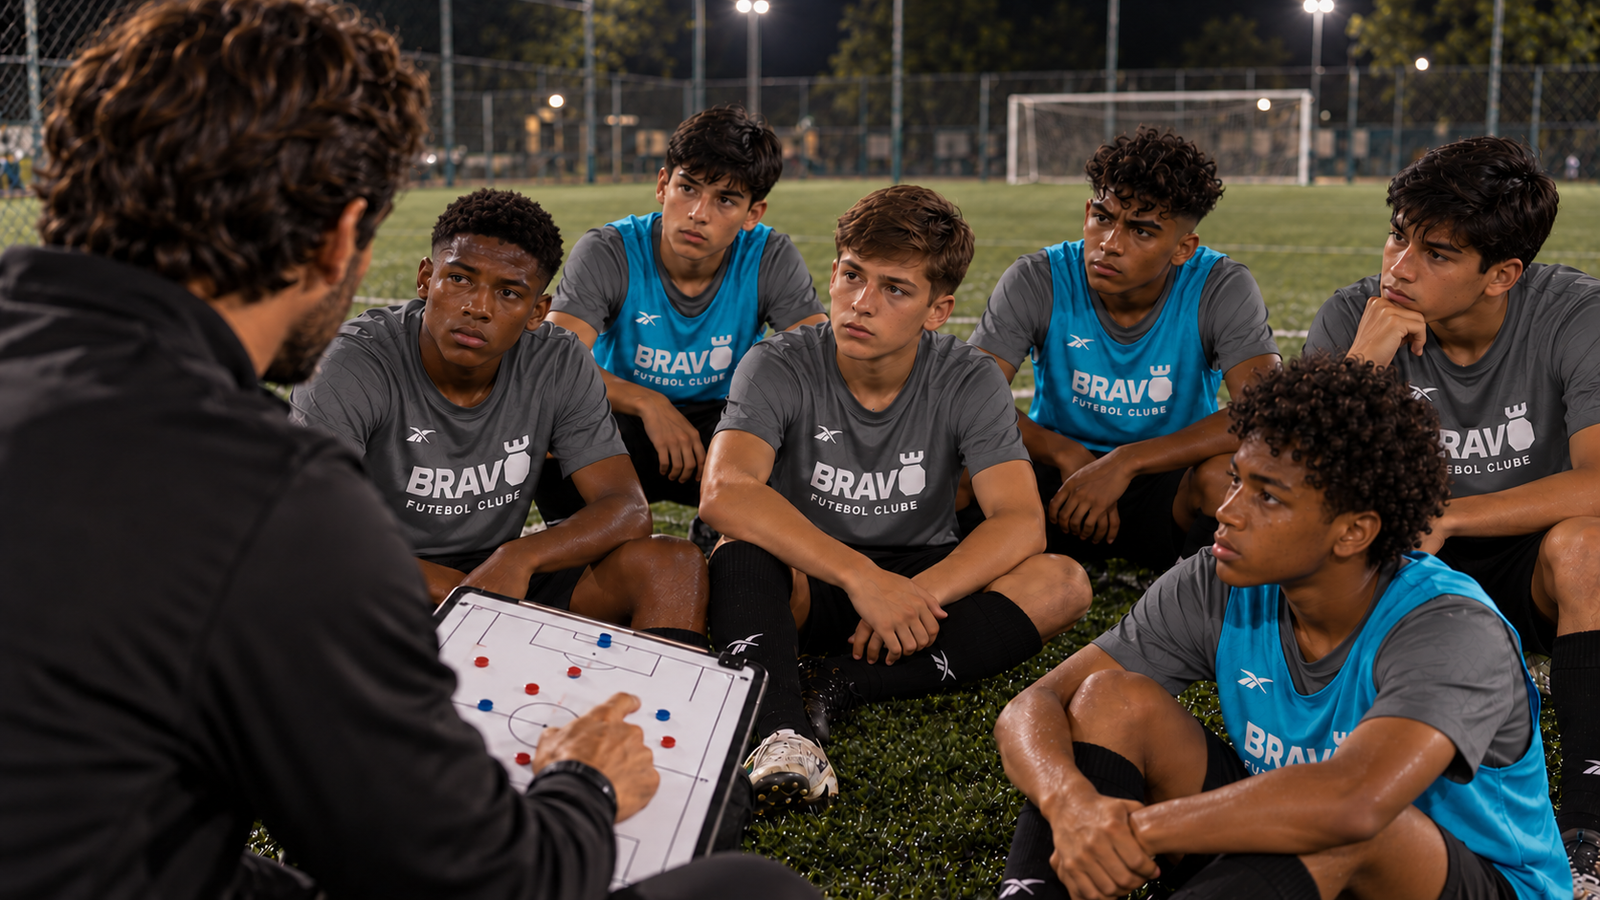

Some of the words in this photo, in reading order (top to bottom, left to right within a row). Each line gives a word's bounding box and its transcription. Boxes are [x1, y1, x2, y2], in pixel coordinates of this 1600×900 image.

[633, 368, 685, 387] FUTEBOL
[688, 372, 726, 386] CLUBE
[1072, 395, 1123, 416] FUTEBOL
[1127, 405, 1167, 417] CLUBE
[1437, 416, 1536, 460] RAVO
[1446, 464, 1481, 475] EBOL
[1486, 454, 1531, 473] CLUBE
[406, 499, 472, 515] FUTEBOL
[477, 489, 521, 510] CLUBE
[810, 493, 869, 516] FUTEBOL
[873, 500, 918, 515] CLUBE
